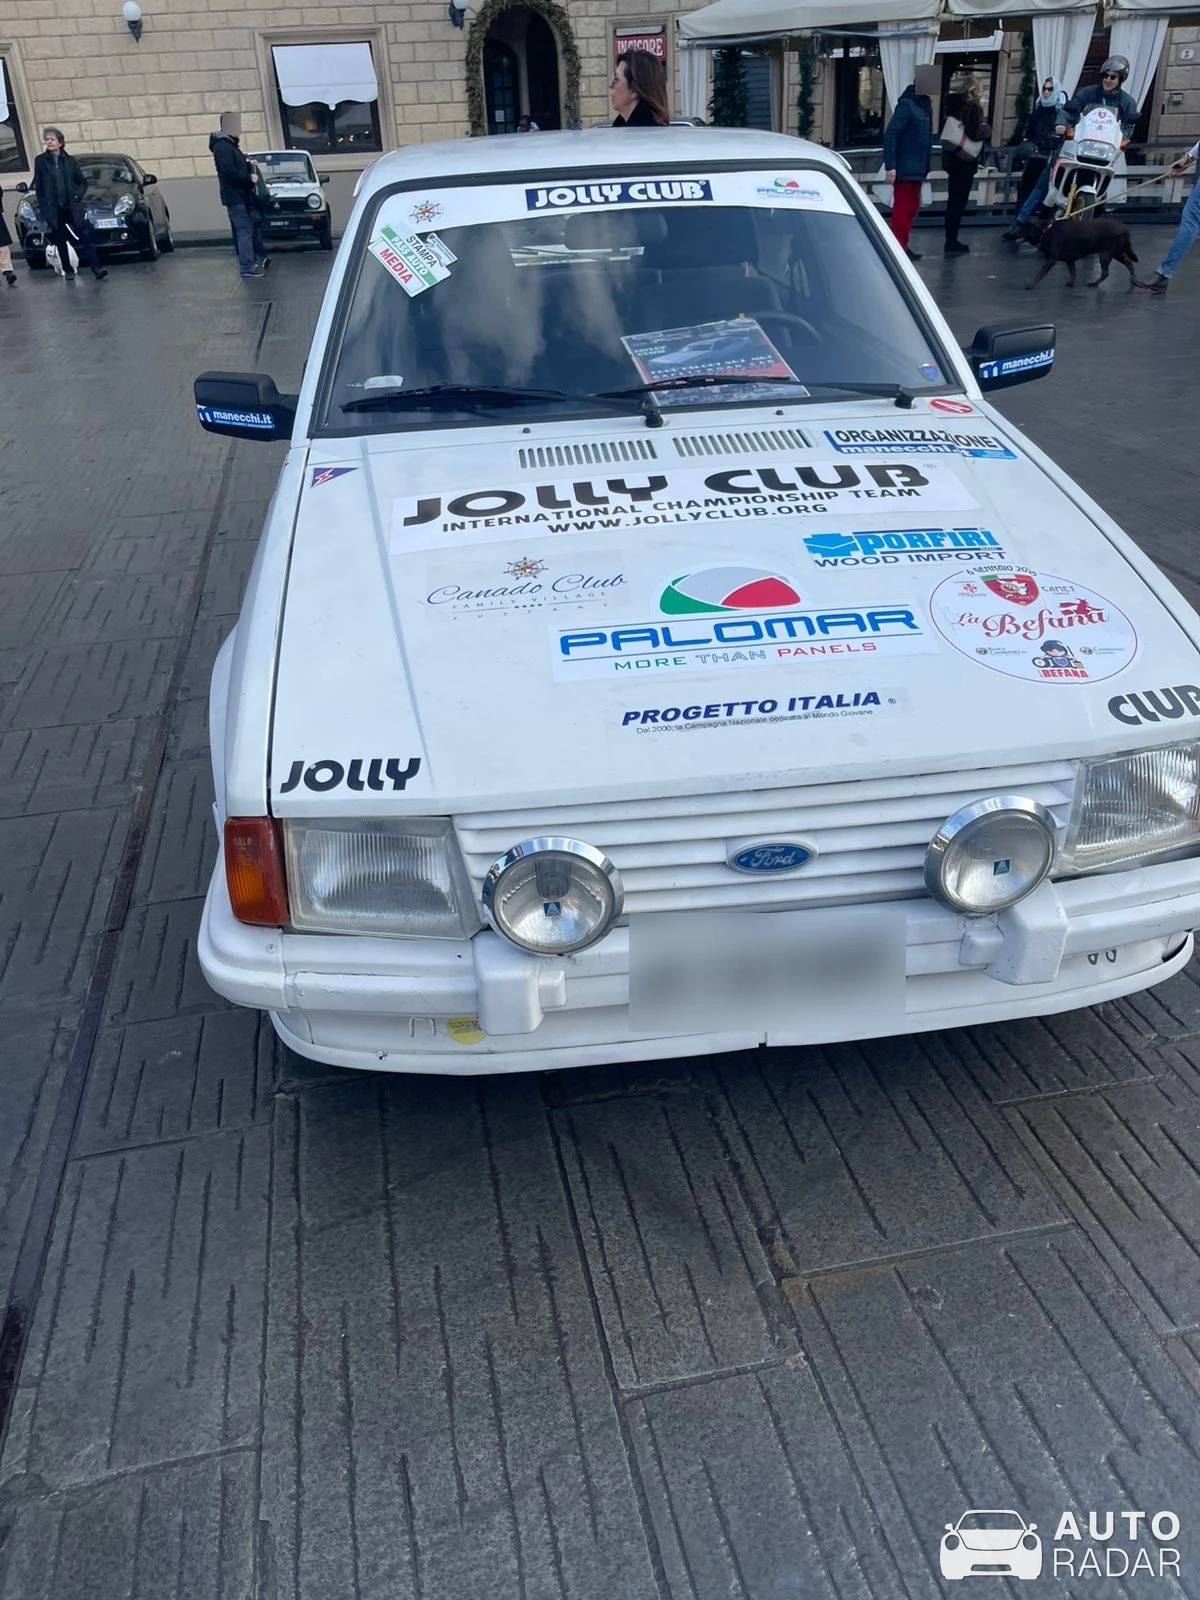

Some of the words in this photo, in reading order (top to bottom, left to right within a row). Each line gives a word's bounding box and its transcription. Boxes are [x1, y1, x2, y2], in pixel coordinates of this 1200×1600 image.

[535, 184, 622, 207] JOLLY
[628, 181, 705, 200] CLUB
[379, 248, 414, 284] MEDIA
[391, 236, 411, 257] PASS
[407, 251, 429, 276] AUTO
[406, 235, 437, 268] STAMPA
[212, 410, 273, 425] manecchi.it
[834, 430, 996, 449] ORGANIZZAZIONE
[403, 475, 669, 527] JOLLY
[704, 464, 930, 495] CLUB
[442, 504, 642, 533] INTERNATIONAL
[652, 490, 839, 511] CHAMPIONSHIP
[848, 488, 922, 499] TEAM
[547, 503, 828, 533] WWW.JOLLYCLUB.ORG
[814, 555, 899, 568] WOOD
[907, 551, 1007, 563] IMPORT
[854, 531, 1000, 556] PORFIRI
[426, 582, 545, 605] Canado
[551, 573, 628, 593] Club
[559, 609, 920, 656] PALOMAR
[951, 612, 981, 627] La
[982, 609, 1110, 641] Befana
[614, 656, 688, 671] MORE
[695, 649, 767, 665] THAN
[777, 642, 878, 658] PANELS
[1043, 669, 1090, 679] BEFANA
[622, 699, 778, 726] PROGETTO
[788, 691, 881, 711] ITALIA
[1107, 684, 1200, 726] CLUB
[637, 726, 651, 735] Dal
[684, 719, 727, 732] Campagna
[729, 713, 768, 728] Nazionale
[769, 712, 802, 723] dedicata
[812, 709, 839, 719] Mondo
[840, 708, 874, 718] Giovane
[280, 757, 421, 794] JOLLY
[750, 848, 797, 868] Ford
